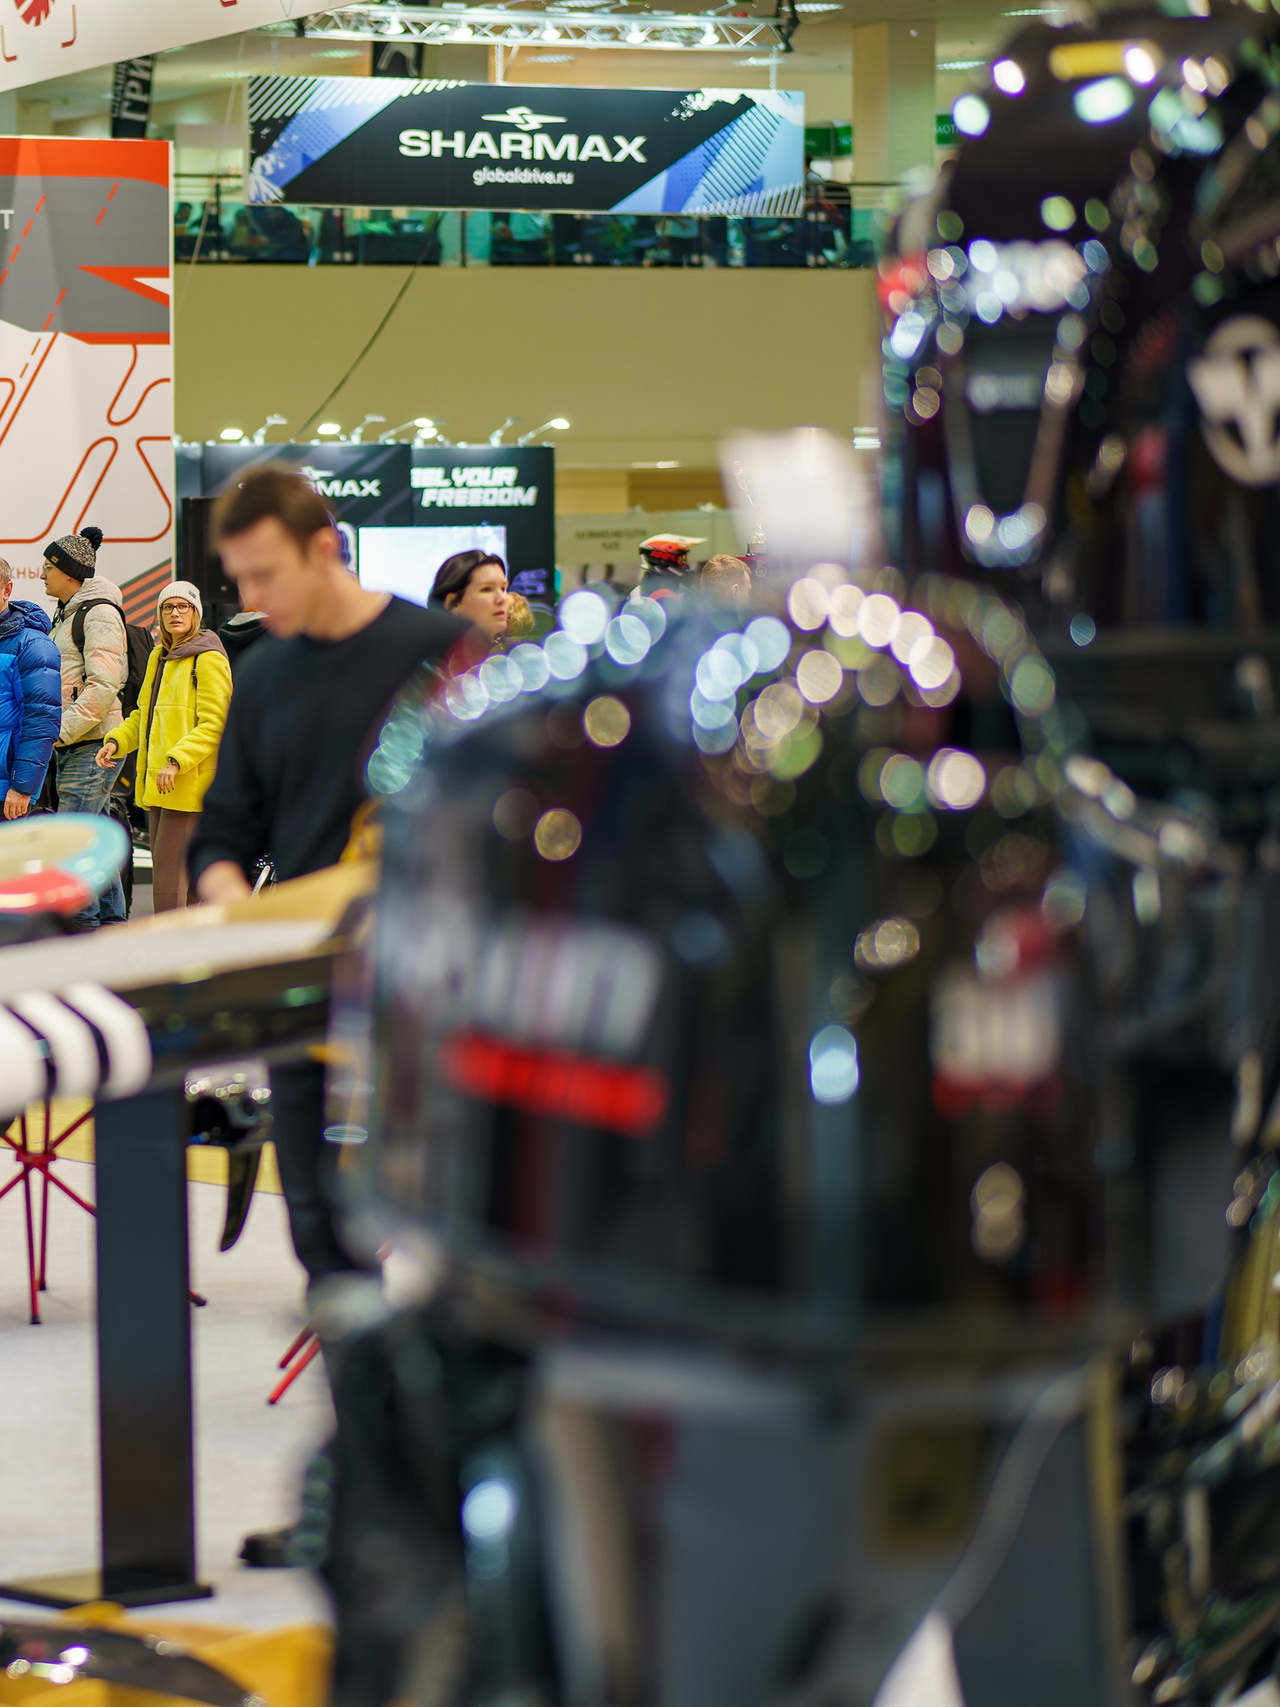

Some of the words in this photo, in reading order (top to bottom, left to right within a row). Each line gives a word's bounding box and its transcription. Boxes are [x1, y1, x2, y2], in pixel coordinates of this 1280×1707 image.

[398, 129, 648, 163] SHARMAX
[472, 166, 574, 186] globaldrive.ru
[451, 466, 518, 487] YOUR
[421, 485, 538, 507] FREEDOM
